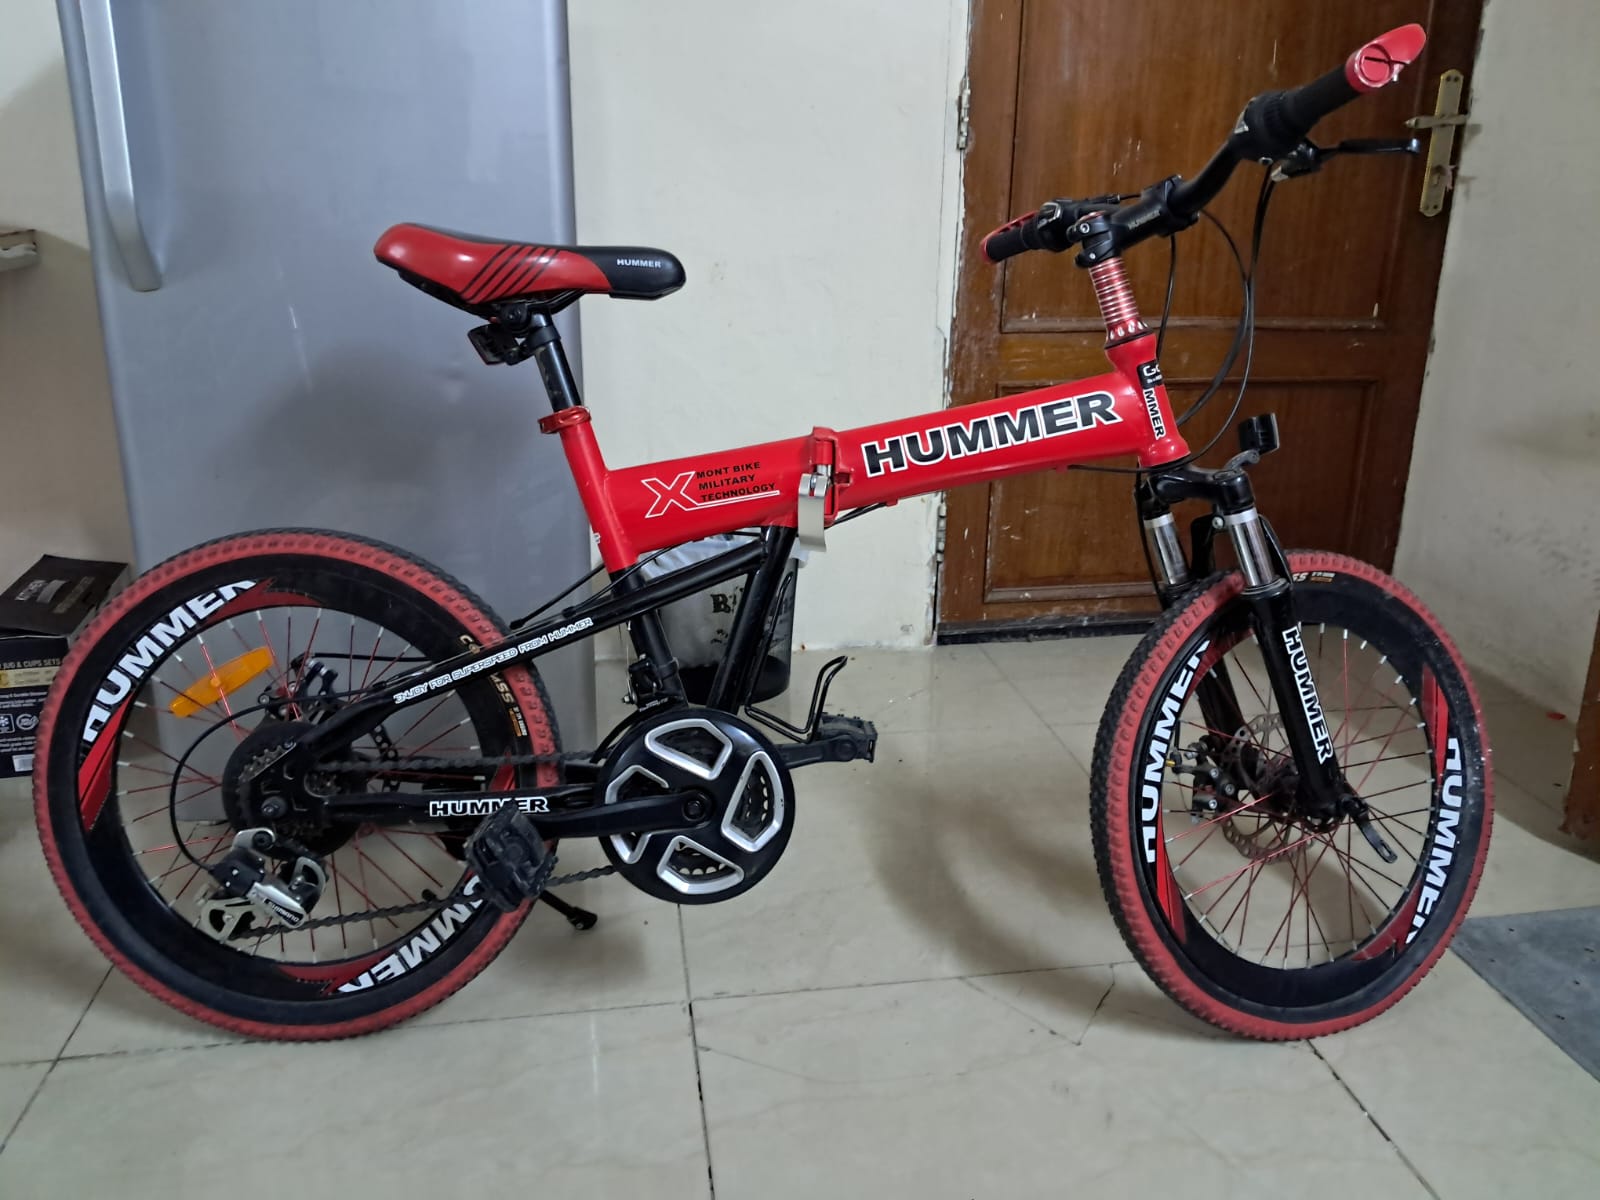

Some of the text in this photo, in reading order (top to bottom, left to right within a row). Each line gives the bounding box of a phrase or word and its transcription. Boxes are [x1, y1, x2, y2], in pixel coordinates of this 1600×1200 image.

[616, 258, 662, 268] HUMMER
[1142, 387, 1167, 441] MMER
[861, 390, 1123, 478] HUMMER
[696, 462, 760, 479] MONT BIKE
[699, 474, 755, 490] MILITARY
[702, 483, 775, 502] TECHNOLOGY
[429, 673, 453, 691] FOR
[452, 648, 517, 681] SUPERSPEED
[518, 637, 548, 656] FROM
[548, 617, 594, 642] HUMMER
[1282, 626, 1334, 765] HUMMER
